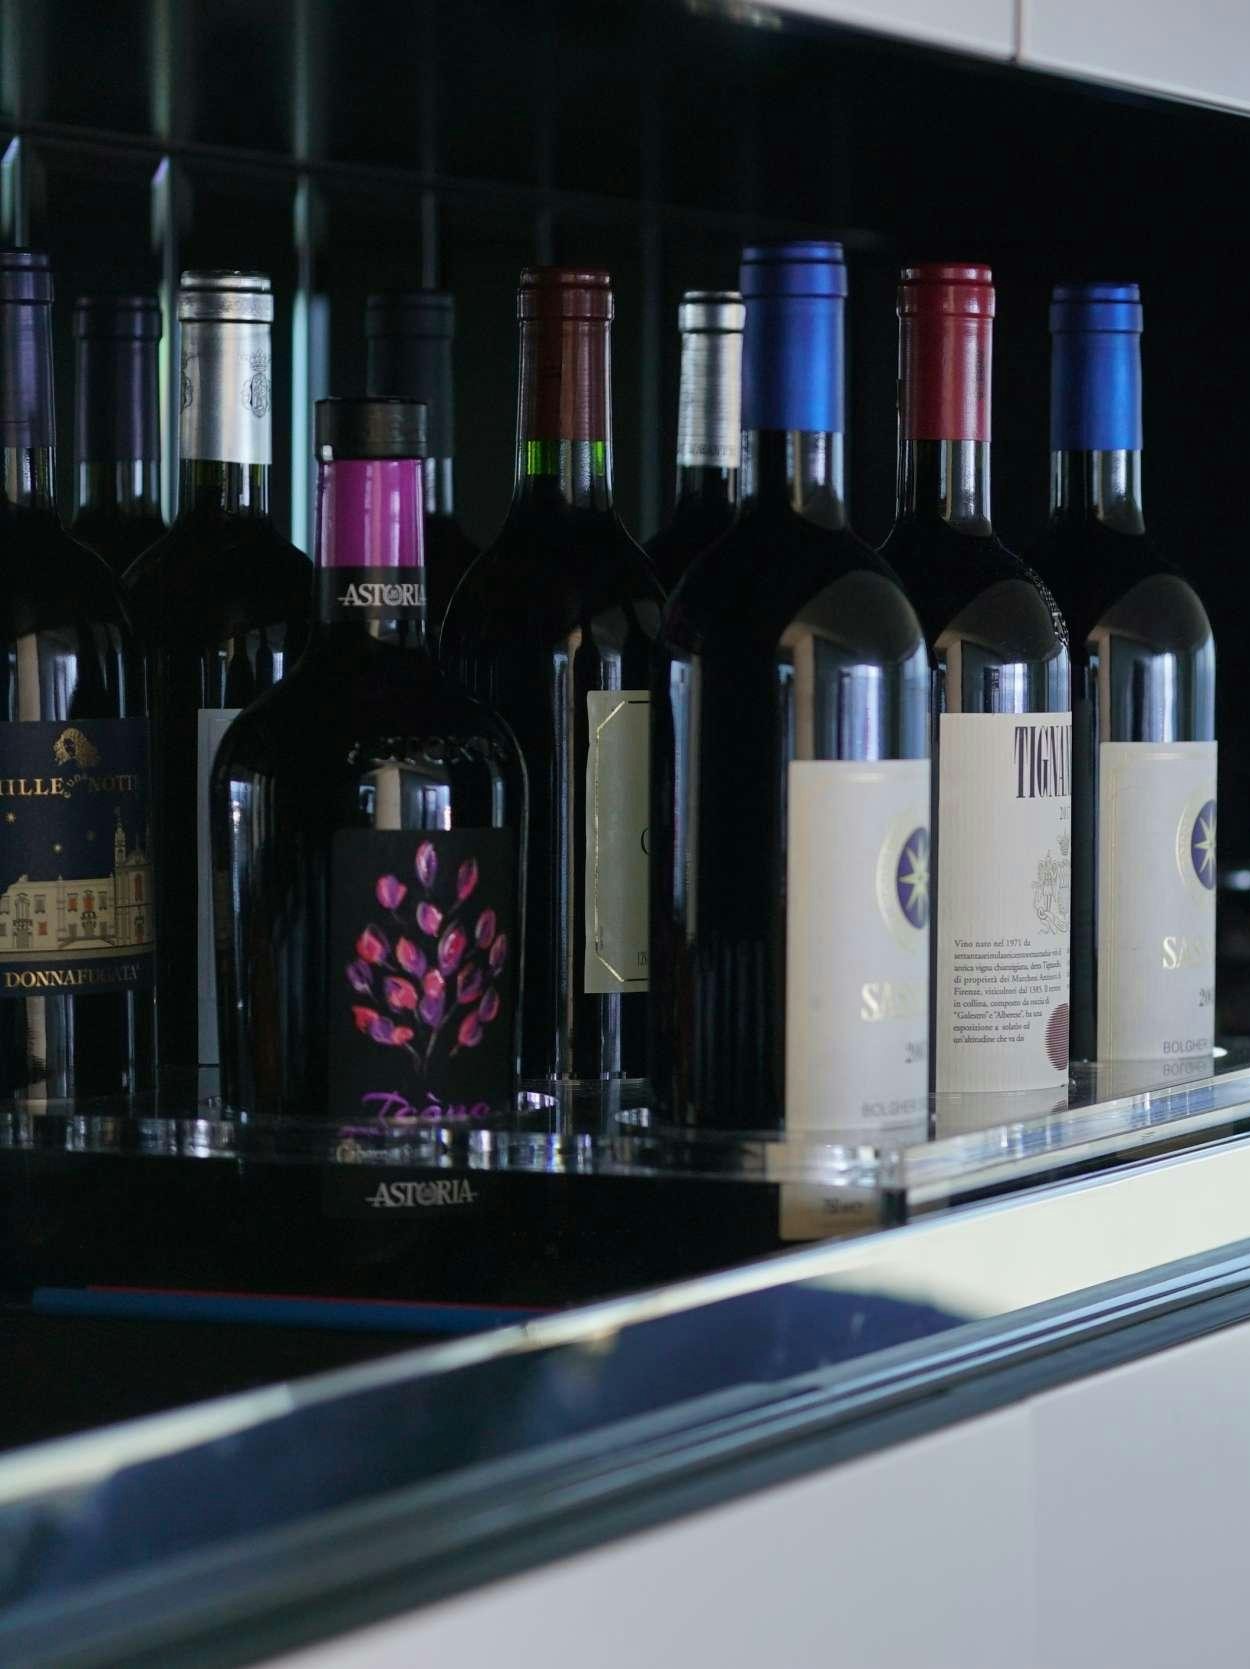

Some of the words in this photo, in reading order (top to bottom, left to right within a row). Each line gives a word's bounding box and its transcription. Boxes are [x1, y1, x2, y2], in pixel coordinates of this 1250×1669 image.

[338, 583, 426, 606] ASTORIA
[0, 777, 64, 796] ILLE
[365, 1178, 478, 1208] ASTORIA
